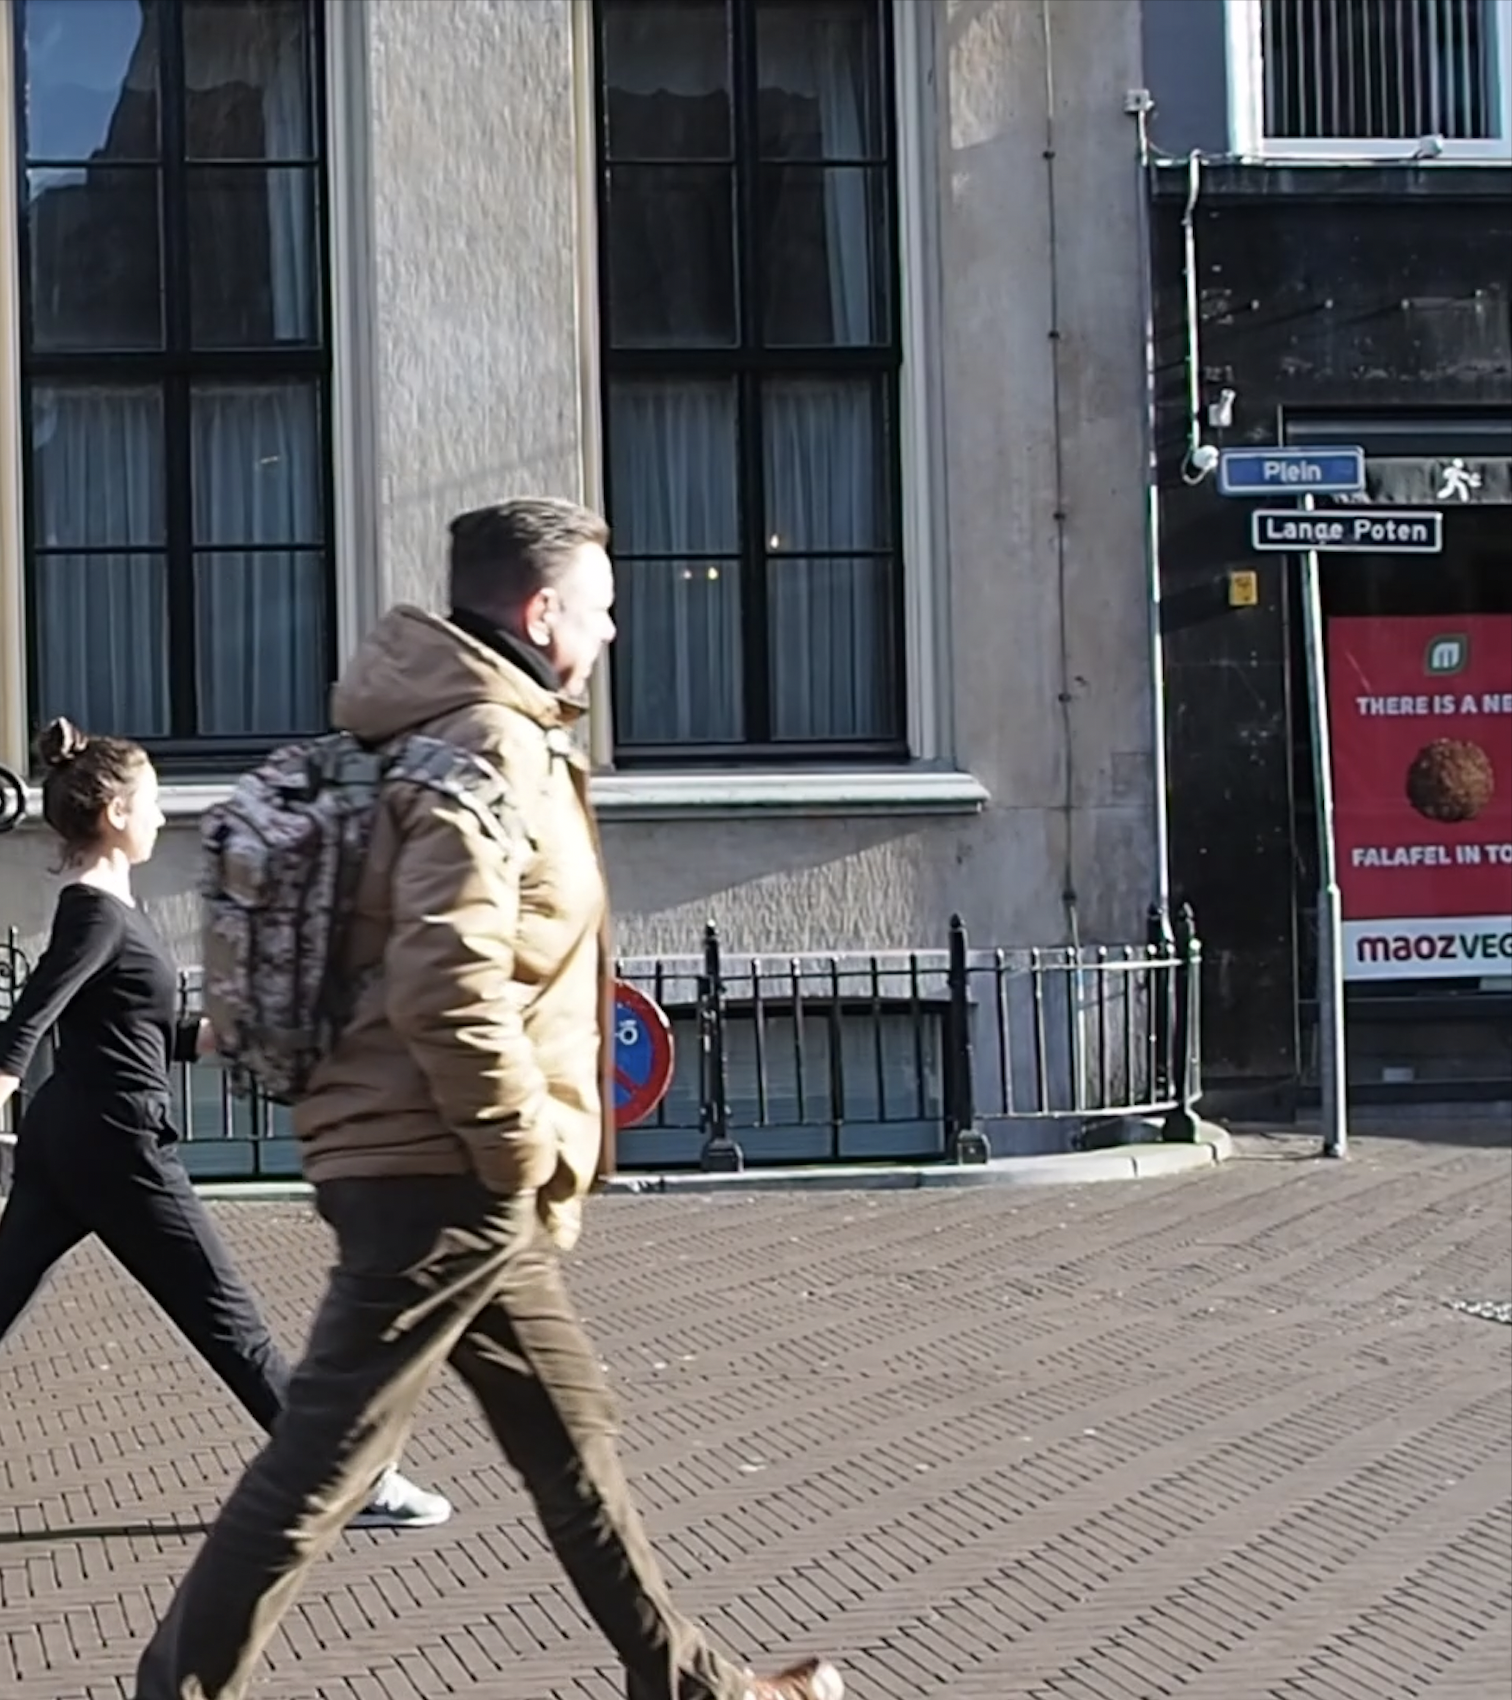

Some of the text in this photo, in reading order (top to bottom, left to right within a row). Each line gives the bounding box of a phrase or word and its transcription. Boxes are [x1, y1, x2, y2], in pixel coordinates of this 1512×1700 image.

[1263, 459, 1322, 482] Plein
[1266, 517, 1428, 545] Lange Poten
[1356, 696, 1429, 716] THERE
[1433, 695, 1456, 714] IS
[1460, 694, 1478, 714] A
[1352, 845, 1452, 868] FALAFEL
[1455, 844, 1481, 864] IN
